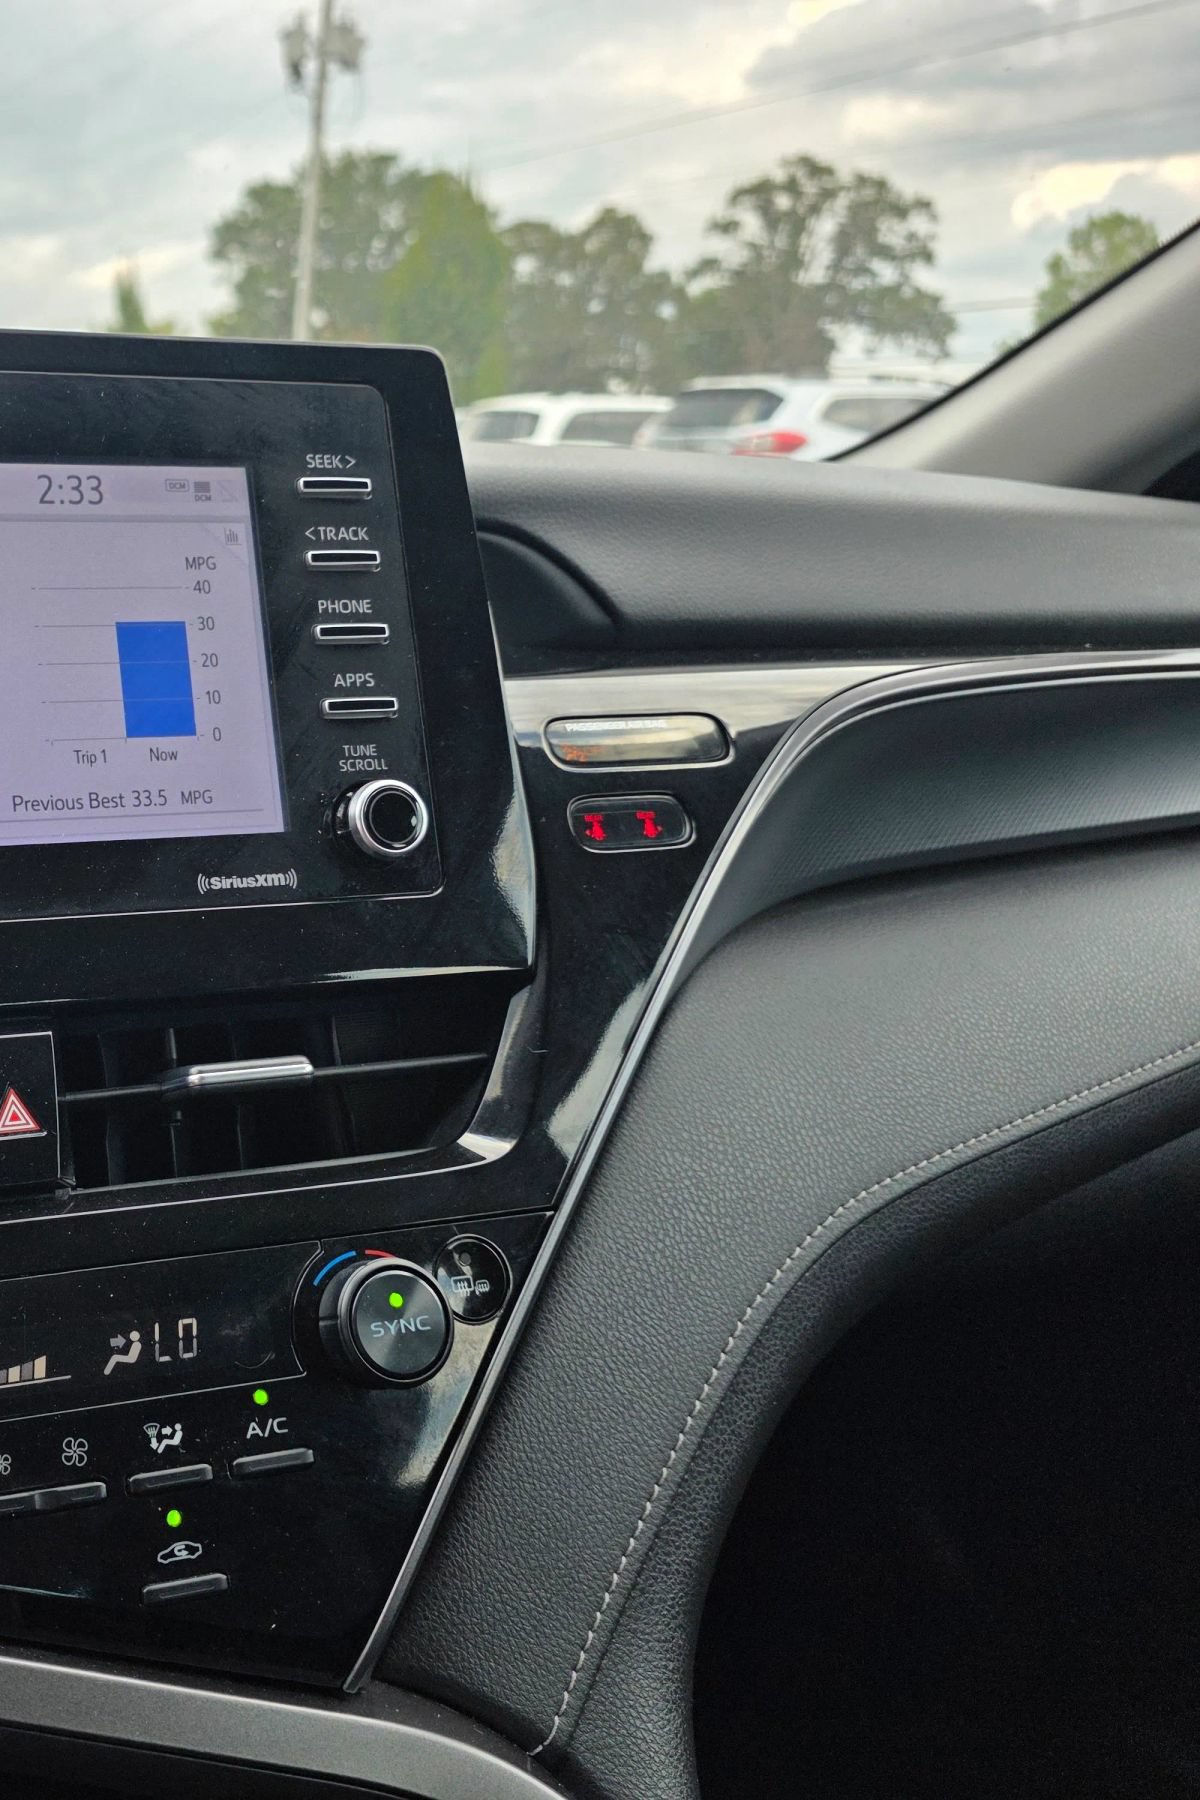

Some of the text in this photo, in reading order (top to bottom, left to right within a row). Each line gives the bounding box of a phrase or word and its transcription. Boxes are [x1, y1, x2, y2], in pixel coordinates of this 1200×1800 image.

[36, 474, 104, 505] 2:33
[194, 494, 212, 502] DCM
[184, 555, 217, 571] MPG
[192, 579, 211, 594] 40
[317, 599, 373, 614] PHONE
[197, 616, 215, 631] 30
[200, 653, 218, 668] 20
[333, 672, 375, 688] APPS
[205, 690, 221, 705] 10
[212, 727, 222, 741] 0
[149, 747, 178, 762] Now
[342, 744, 377, 757] TUNE
[72, 749, 107, 768] Trip 1
[338, 758, 389, 772] SCROLL
[12, 789, 213, 812] Previous Best 33.5 MPG
[370, 1315, 432, 1338] SYNC
[154, 1317, 198, 1362] LO
[246, 1417, 289, 1439] A/C
